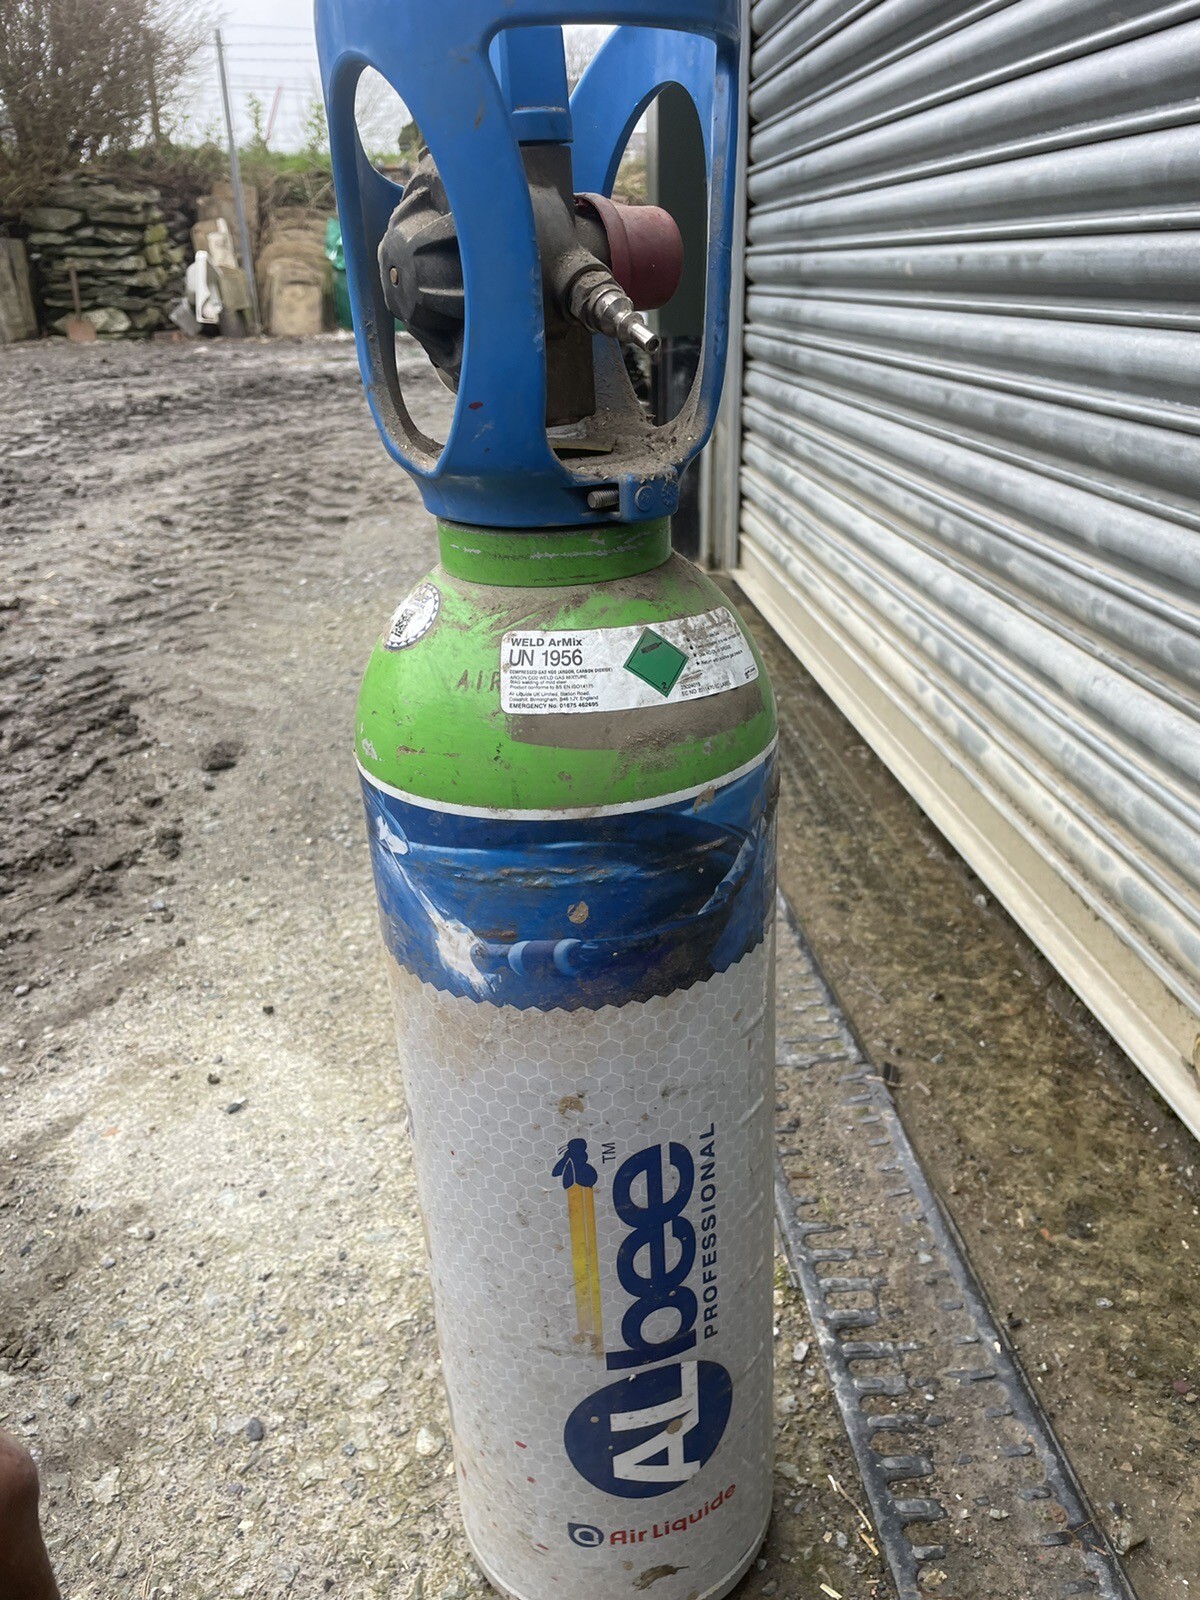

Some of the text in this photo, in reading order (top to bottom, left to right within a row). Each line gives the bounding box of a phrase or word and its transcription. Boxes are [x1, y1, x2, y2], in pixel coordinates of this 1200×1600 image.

[511, 637, 583, 647] WELD ArMix
[509, 648, 583, 667] UN 1956
[661, 681, 668, 690] 2
[602, 1142, 616, 1164] TM
[700, 1122, 719, 1340] PROFESSIONAL
[606, 1142, 700, 1483] ALbee
[610, 1484, 736, 1546] Air Liquide
